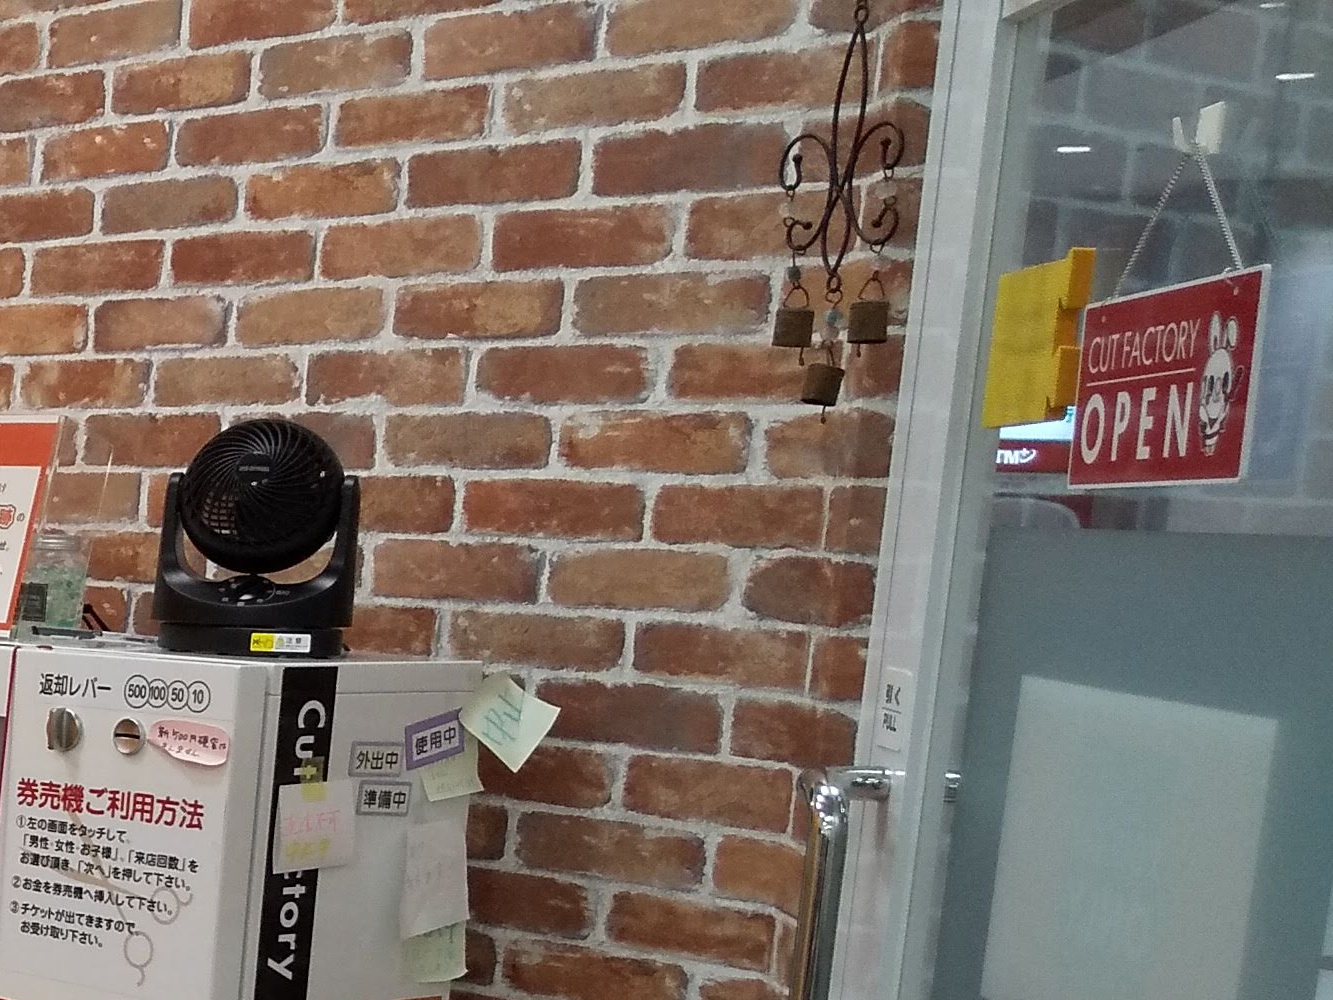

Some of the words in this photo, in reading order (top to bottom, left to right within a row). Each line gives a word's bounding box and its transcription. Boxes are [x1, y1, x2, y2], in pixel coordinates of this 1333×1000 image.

[1088, 332, 1118, 374] CUT
[1120, 318, 1201, 368] FACTORY
[1081, 381, 1194, 464] OPEN
[39, 673, 111, 699] 返却レバー
[127, 683, 147, 699] 500
[150, 686, 166, 700] 100
[171, 687, 185, 703] 50
[192, 689, 204, 705] 10
[294, 699, 326, 779] Cut
[415, 727, 457, 755] 使用中
[356, 751, 399, 771] 外出中
[17, 778, 204, 830] 券売機ご利用方法
[363, 789, 407, 811] 準備中
[20, 920, 103, 948] お受け取り下さい。
